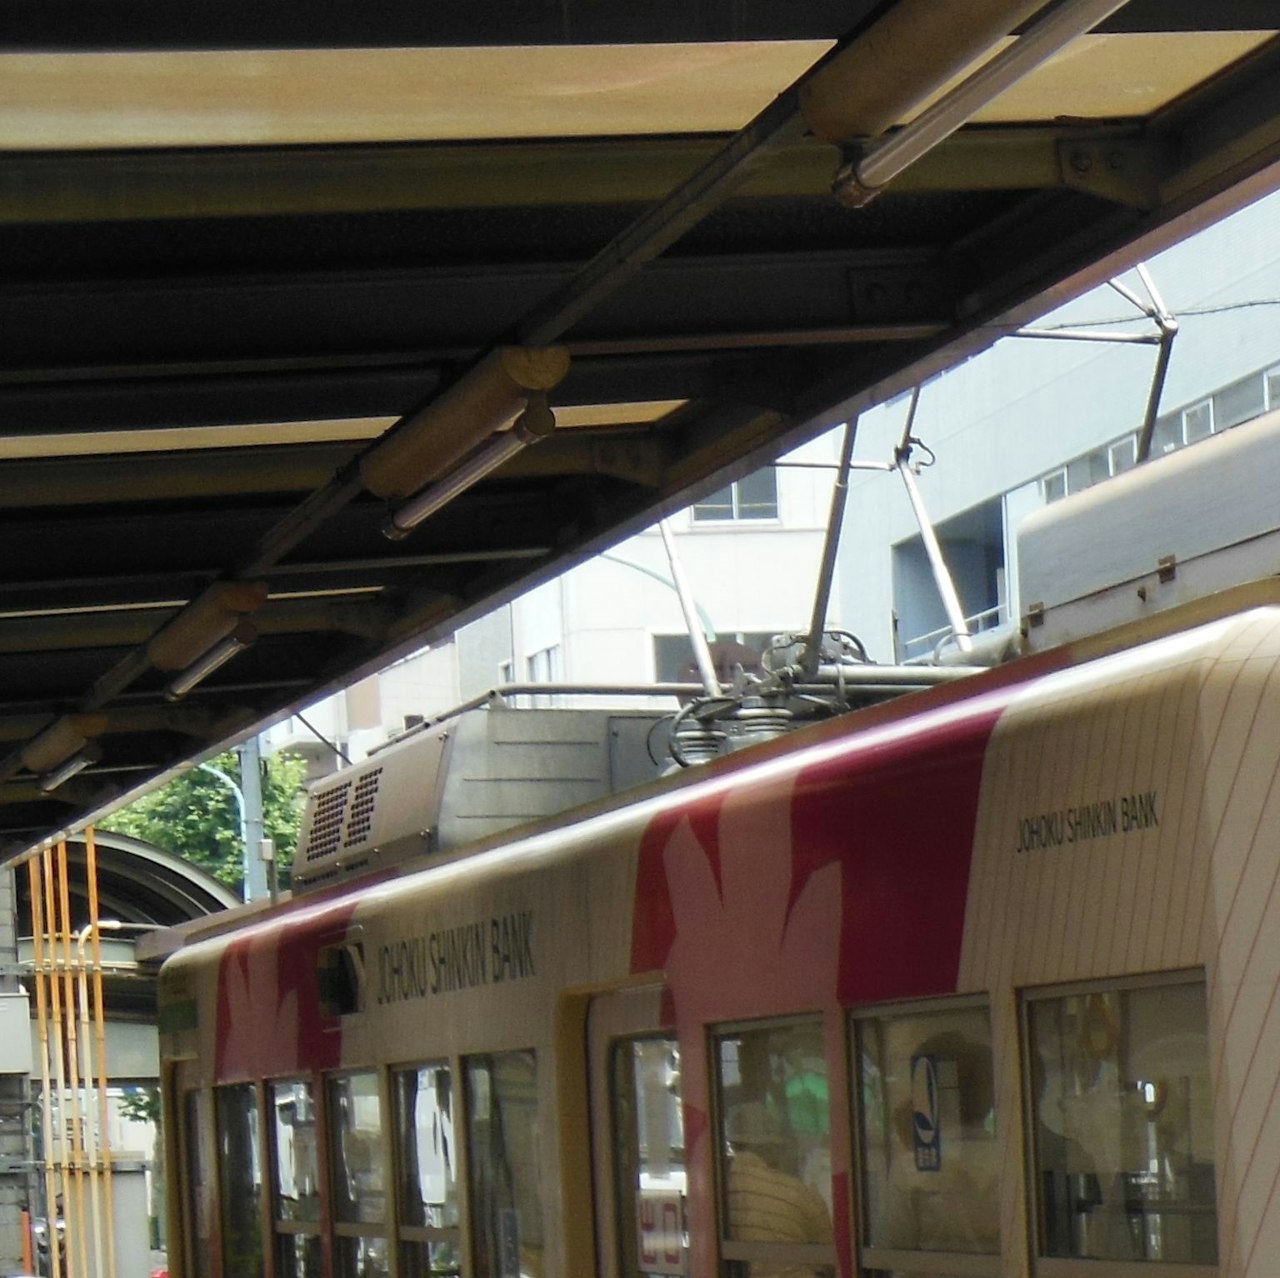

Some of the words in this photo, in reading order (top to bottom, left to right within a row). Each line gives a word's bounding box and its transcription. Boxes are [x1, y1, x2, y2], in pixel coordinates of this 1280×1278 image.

[1016, 812, 1065, 853] JOHOKU
[1067, 800, 1117, 842] SHINKIN
[1121, 790, 1160, 832] BANK
[430, 920, 487, 994] SHINKIN
[491, 910, 536, 983] BANK
